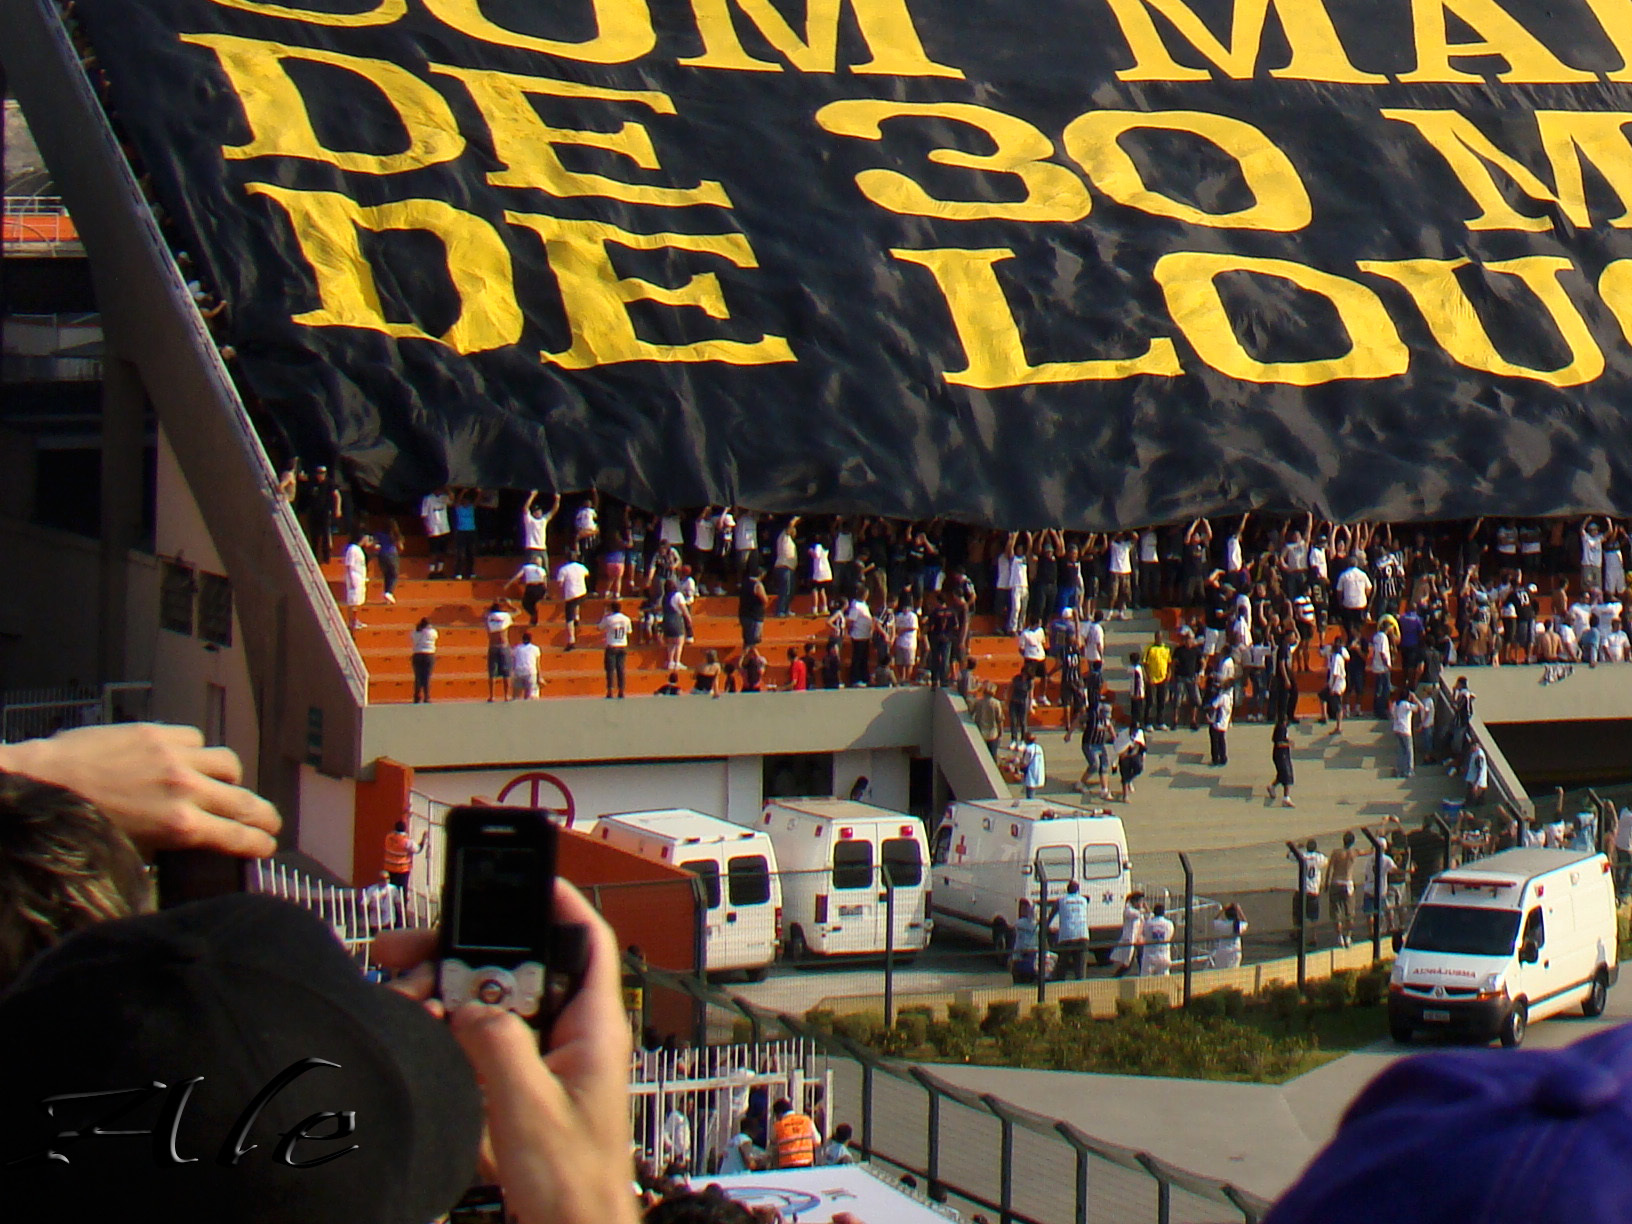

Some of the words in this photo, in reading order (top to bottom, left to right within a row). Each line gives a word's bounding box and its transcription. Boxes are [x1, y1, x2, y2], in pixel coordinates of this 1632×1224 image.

[178, 33, 734, 209] DE
[814, 99, 1313, 232] 30
[244, 182, 798, 370] DE
